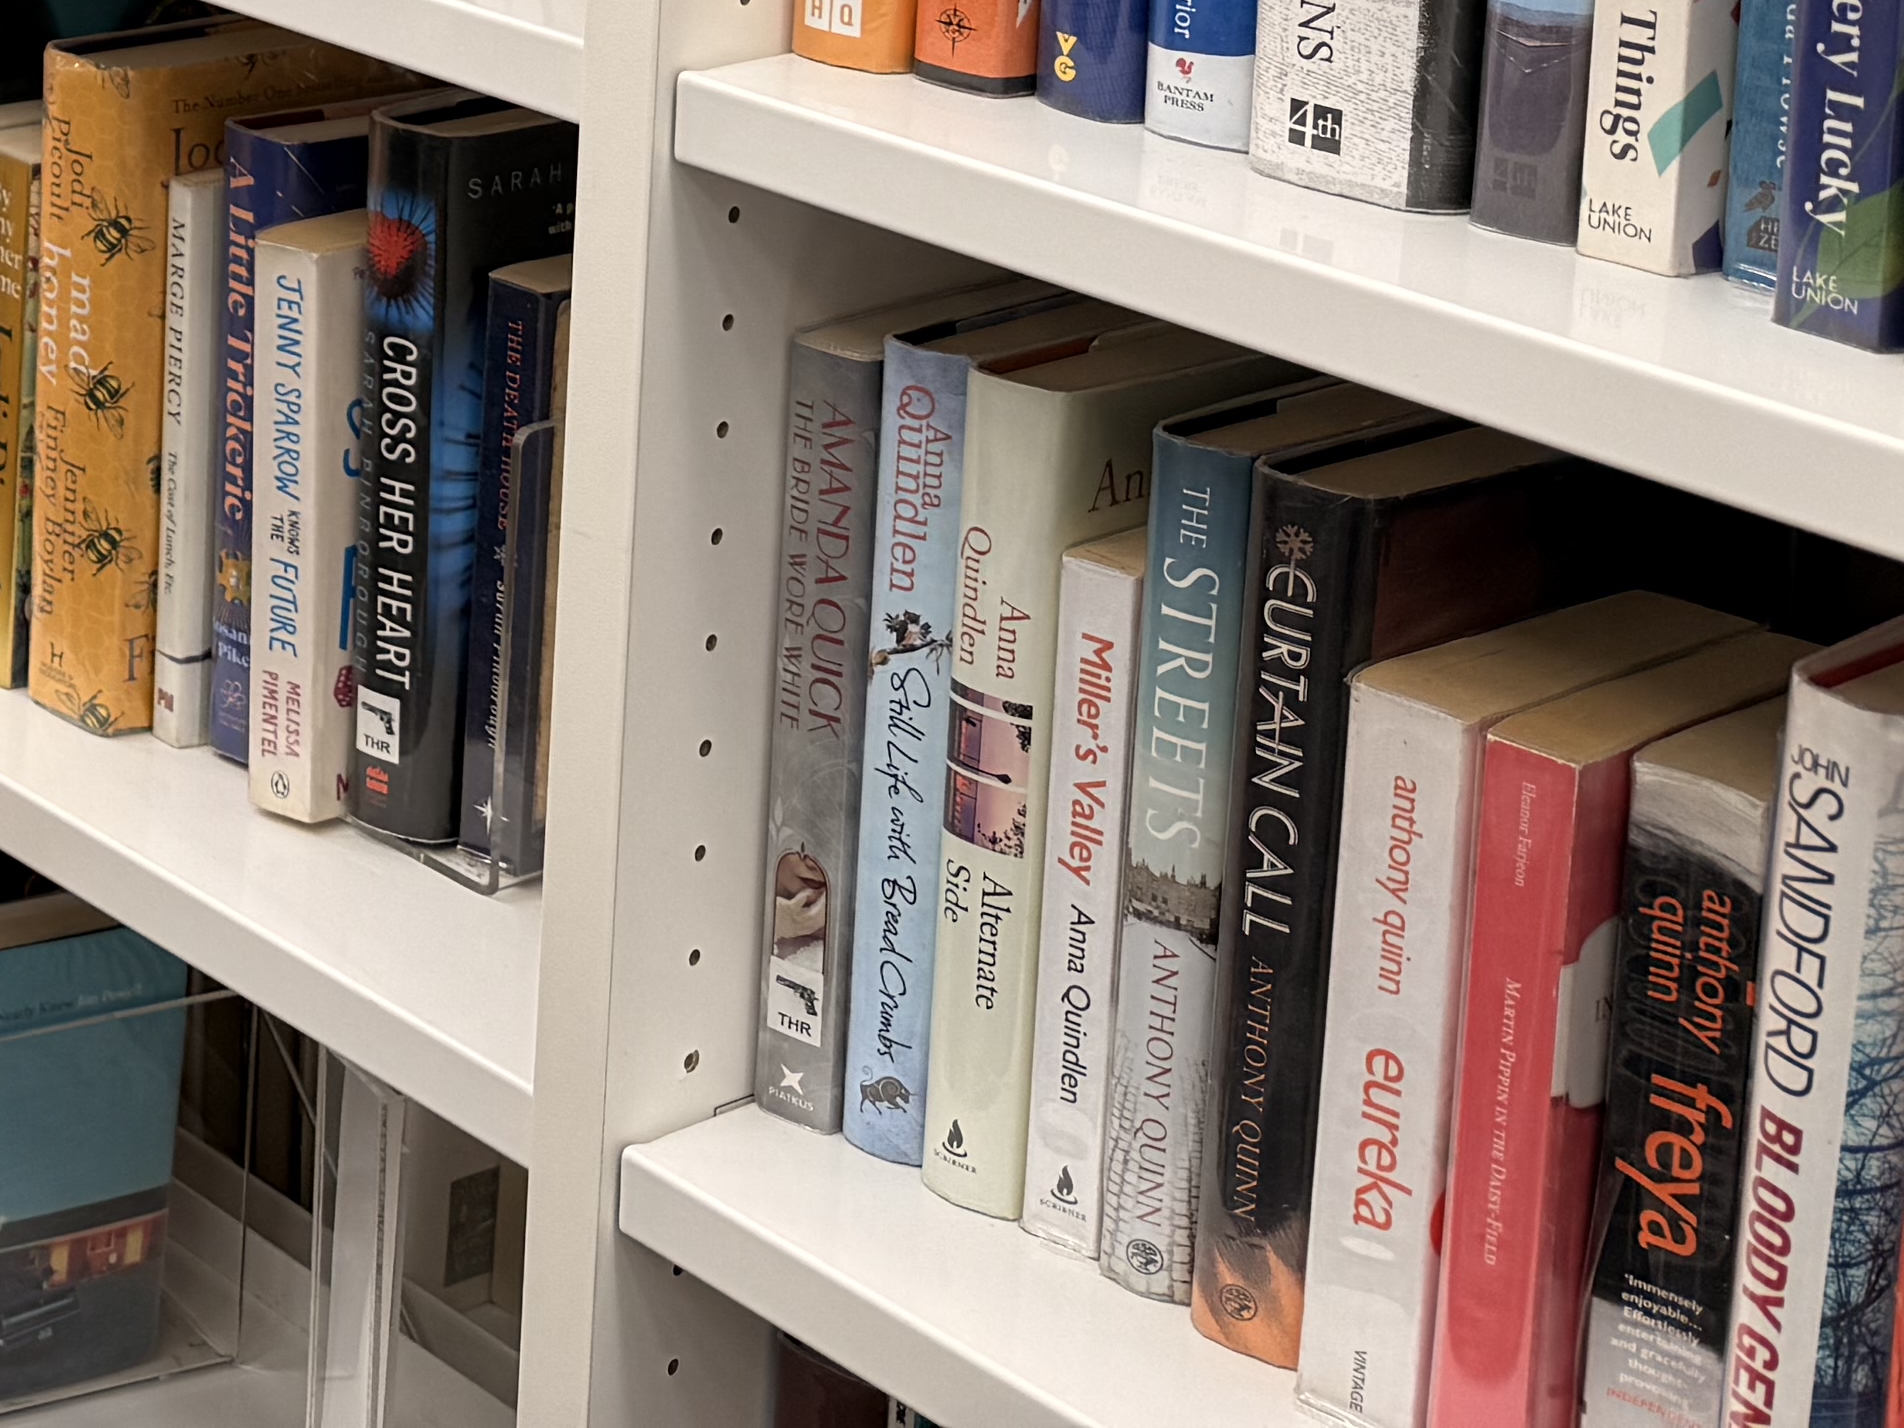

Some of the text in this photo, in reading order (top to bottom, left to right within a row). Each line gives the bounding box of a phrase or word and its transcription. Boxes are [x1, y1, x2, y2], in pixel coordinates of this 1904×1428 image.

[1598, 10, 1657, 164] Things
[1588, 198, 1635, 224] LAKE
[1588, 216, 1655, 243] UNION
[269, 274, 305, 503] JENNY SPARROW
[374, 336, 419, 690] CROSS HER HEART
[1143, 485, 1221, 850] THE STREETS
[1242, 563, 1317, 938] CURTAIN CALL
[1051, 631, 1117, 1107] Miller's Valley Anna Quindlen
[1373, 774, 1416, 996] anthony quinn
[1640, 895, 1684, 1003] quinn
[1679, 889, 1741, 1054] anthony
[1132, 937, 1180, 1226] ANTHONY QUINN
[1352, 1047, 1407, 1234] eureka
[1615, 1072, 1733, 1258] freya
[1735, 783, 1844, 1327] SANDFORD BLOODY
